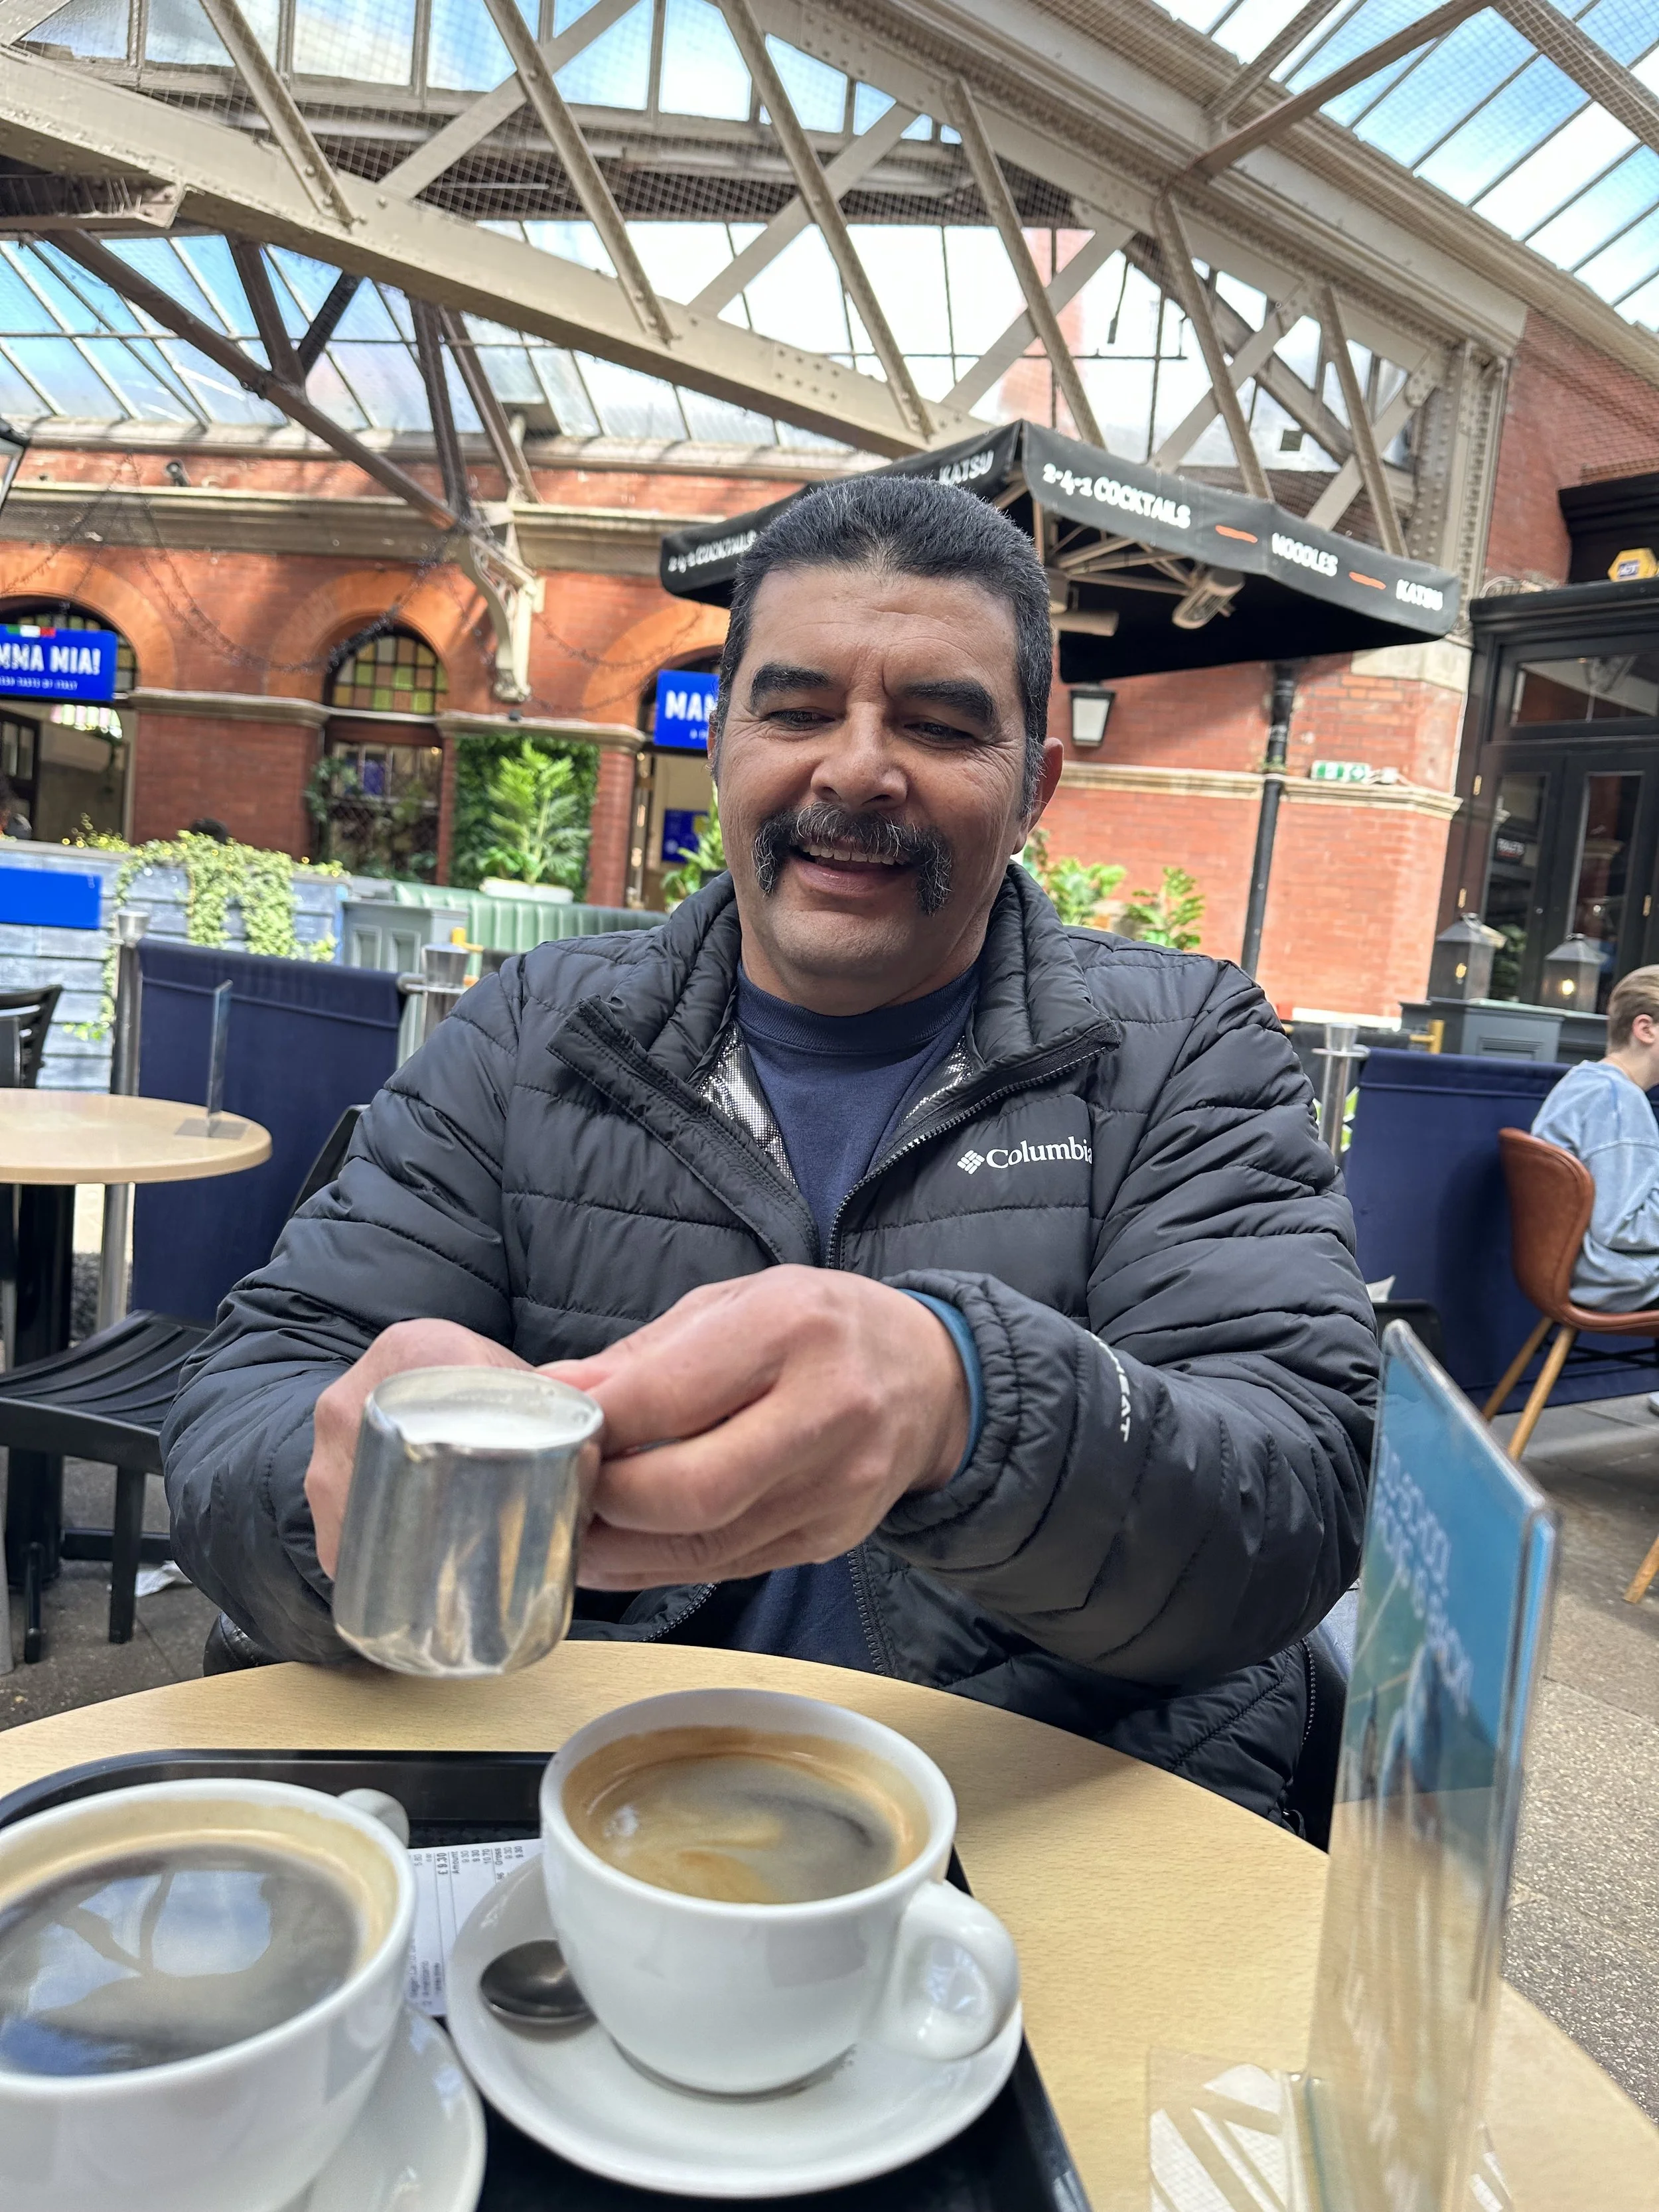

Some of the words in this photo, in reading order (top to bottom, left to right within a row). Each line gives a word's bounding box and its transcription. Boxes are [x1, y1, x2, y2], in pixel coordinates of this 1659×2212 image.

[938, 449, 994, 486] KATSU
[1043, 463, 1093, 497] 2-4-1
[1094, 477, 1191, 529] COCKTAILS
[1272, 532, 1338, 577] NOODLES
[1396, 579, 1443, 611] KATSU
[451, 1851, 460, 1874] Amount
[494, 1847, 503, 1865] Gross
